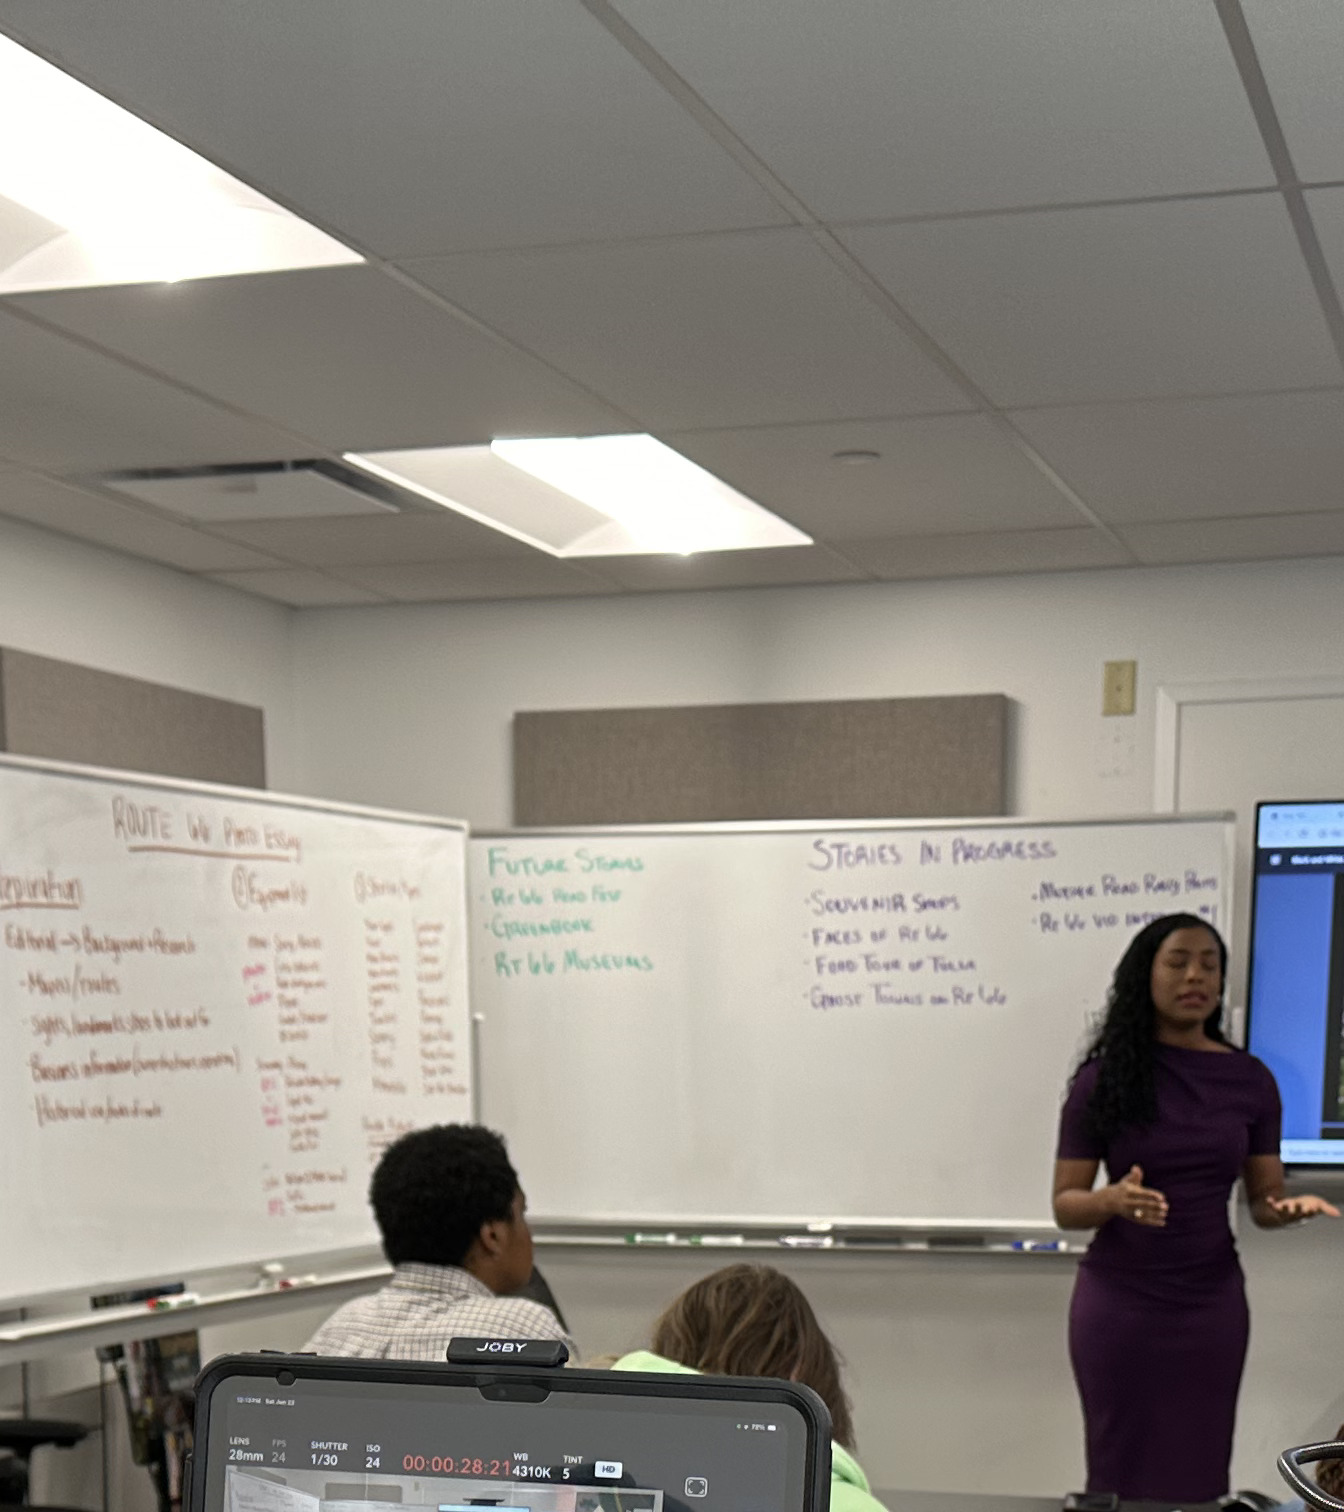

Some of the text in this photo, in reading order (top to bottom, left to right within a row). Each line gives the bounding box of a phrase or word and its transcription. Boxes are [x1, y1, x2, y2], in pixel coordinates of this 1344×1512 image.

[111, 795, 174, 841] ROUTE
[808, 837, 1058, 872] STORIES IN PROGRESS
[488, 847, 569, 878] FUTURE
[563, 948, 654, 973] MUSEUMS
[476, 1342, 528, 1354] JOBY
[229, 1436, 250, 1446] LENS
[271, 1438, 287, 1448] FPS
[311, 1440, 348, 1452] SHUTTER
[366, 1444, 381, 1453] ISO
[228, 1449, 264, 1462] 28mm
[271, 1451, 286, 1464] 24
[311, 1453, 339, 1467] 1/30
[513, 1452, 529, 1462] WB
[563, 1454, 584, 1465] TINT
[365, 1456, 381, 1469] 24
[402, 1453, 511, 1477] 00:00:28:21
[512, 1464, 552, 1479] 4310K
[562, 1467, 570, 1480] 5
